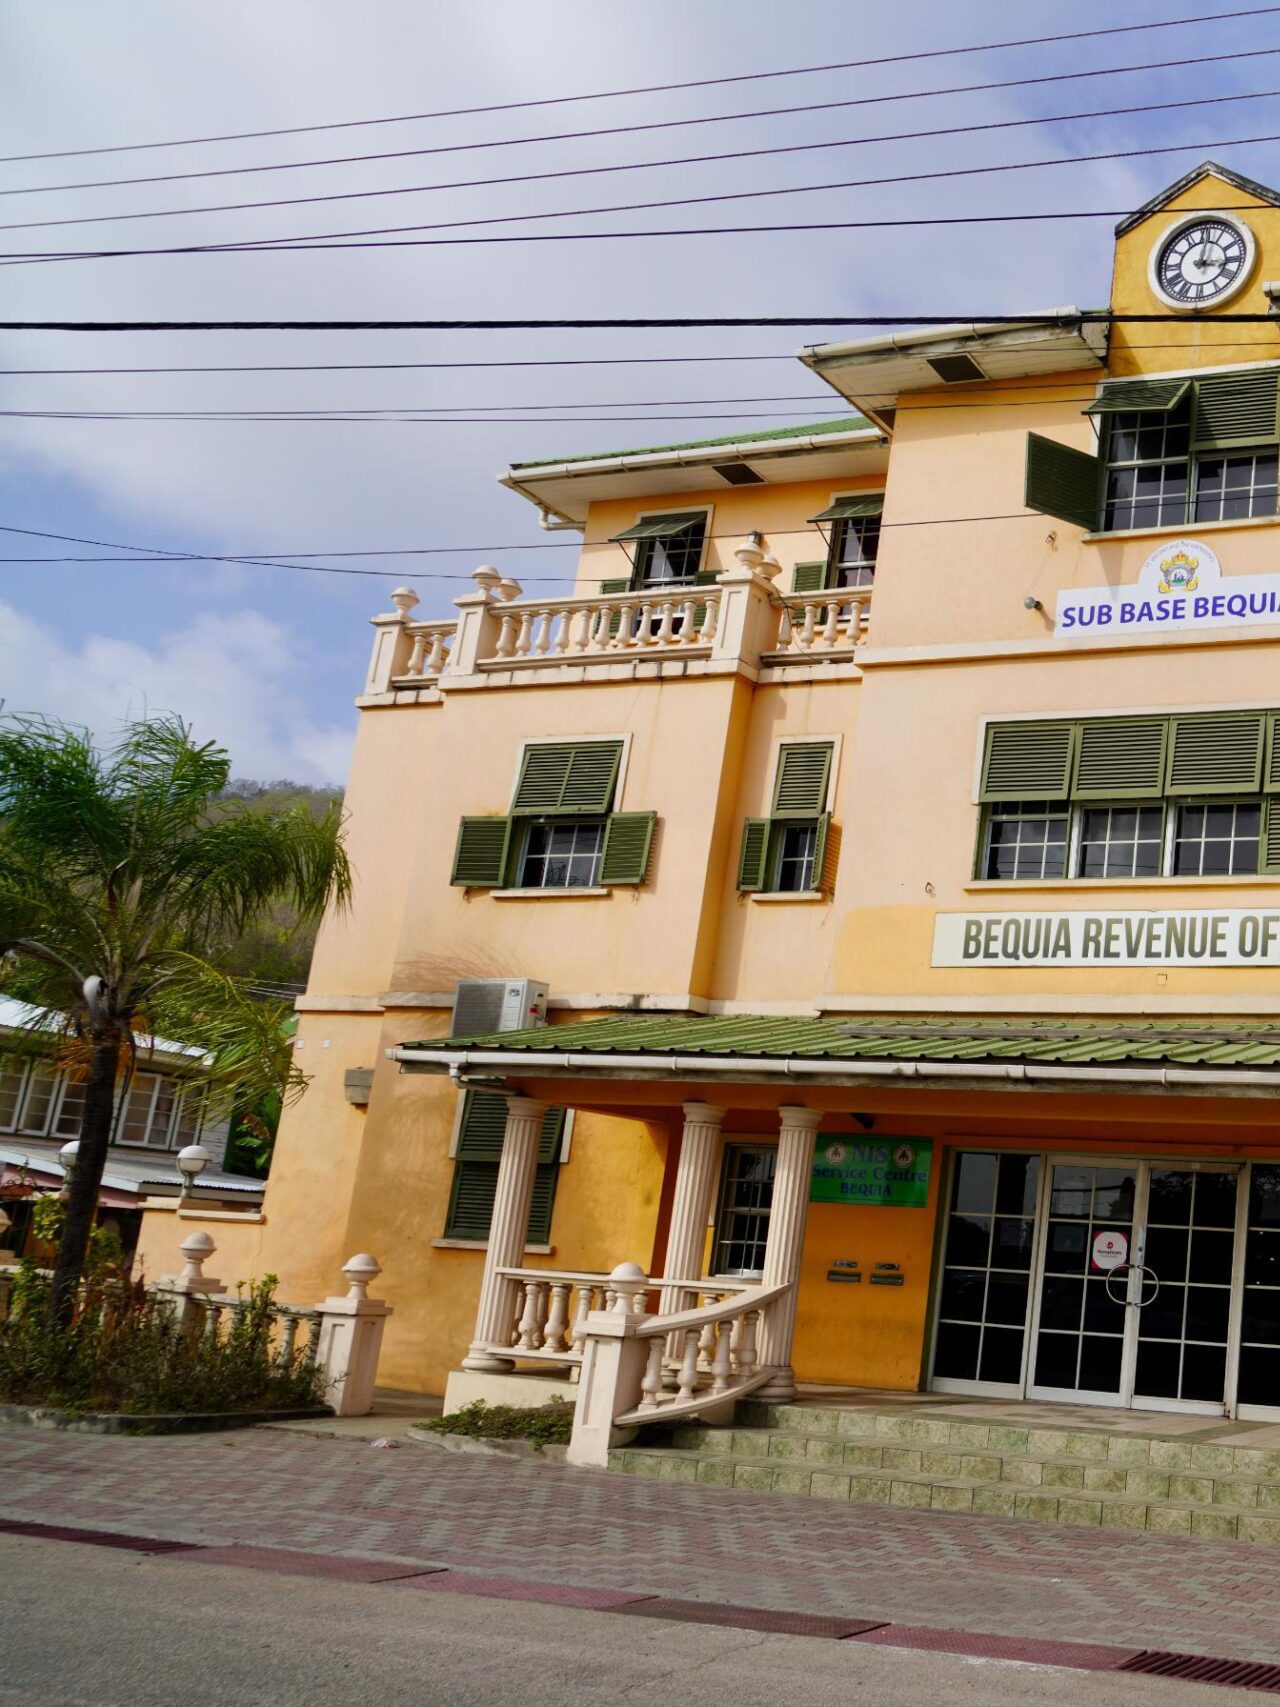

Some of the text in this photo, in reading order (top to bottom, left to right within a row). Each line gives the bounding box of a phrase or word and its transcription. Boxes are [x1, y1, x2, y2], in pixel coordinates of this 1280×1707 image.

[1062, 604, 1112, 628] SUB
[1119, 598, 1186, 623] BASE
[962, 918, 1072, 960] BEQUIA
[1081, 916, 1230, 959] REVENUE
[851, 1144, 889, 1164] NIS
[813, 1164, 928, 1183] Service Centre
[839, 1182, 893, 1197] BEQUIA
